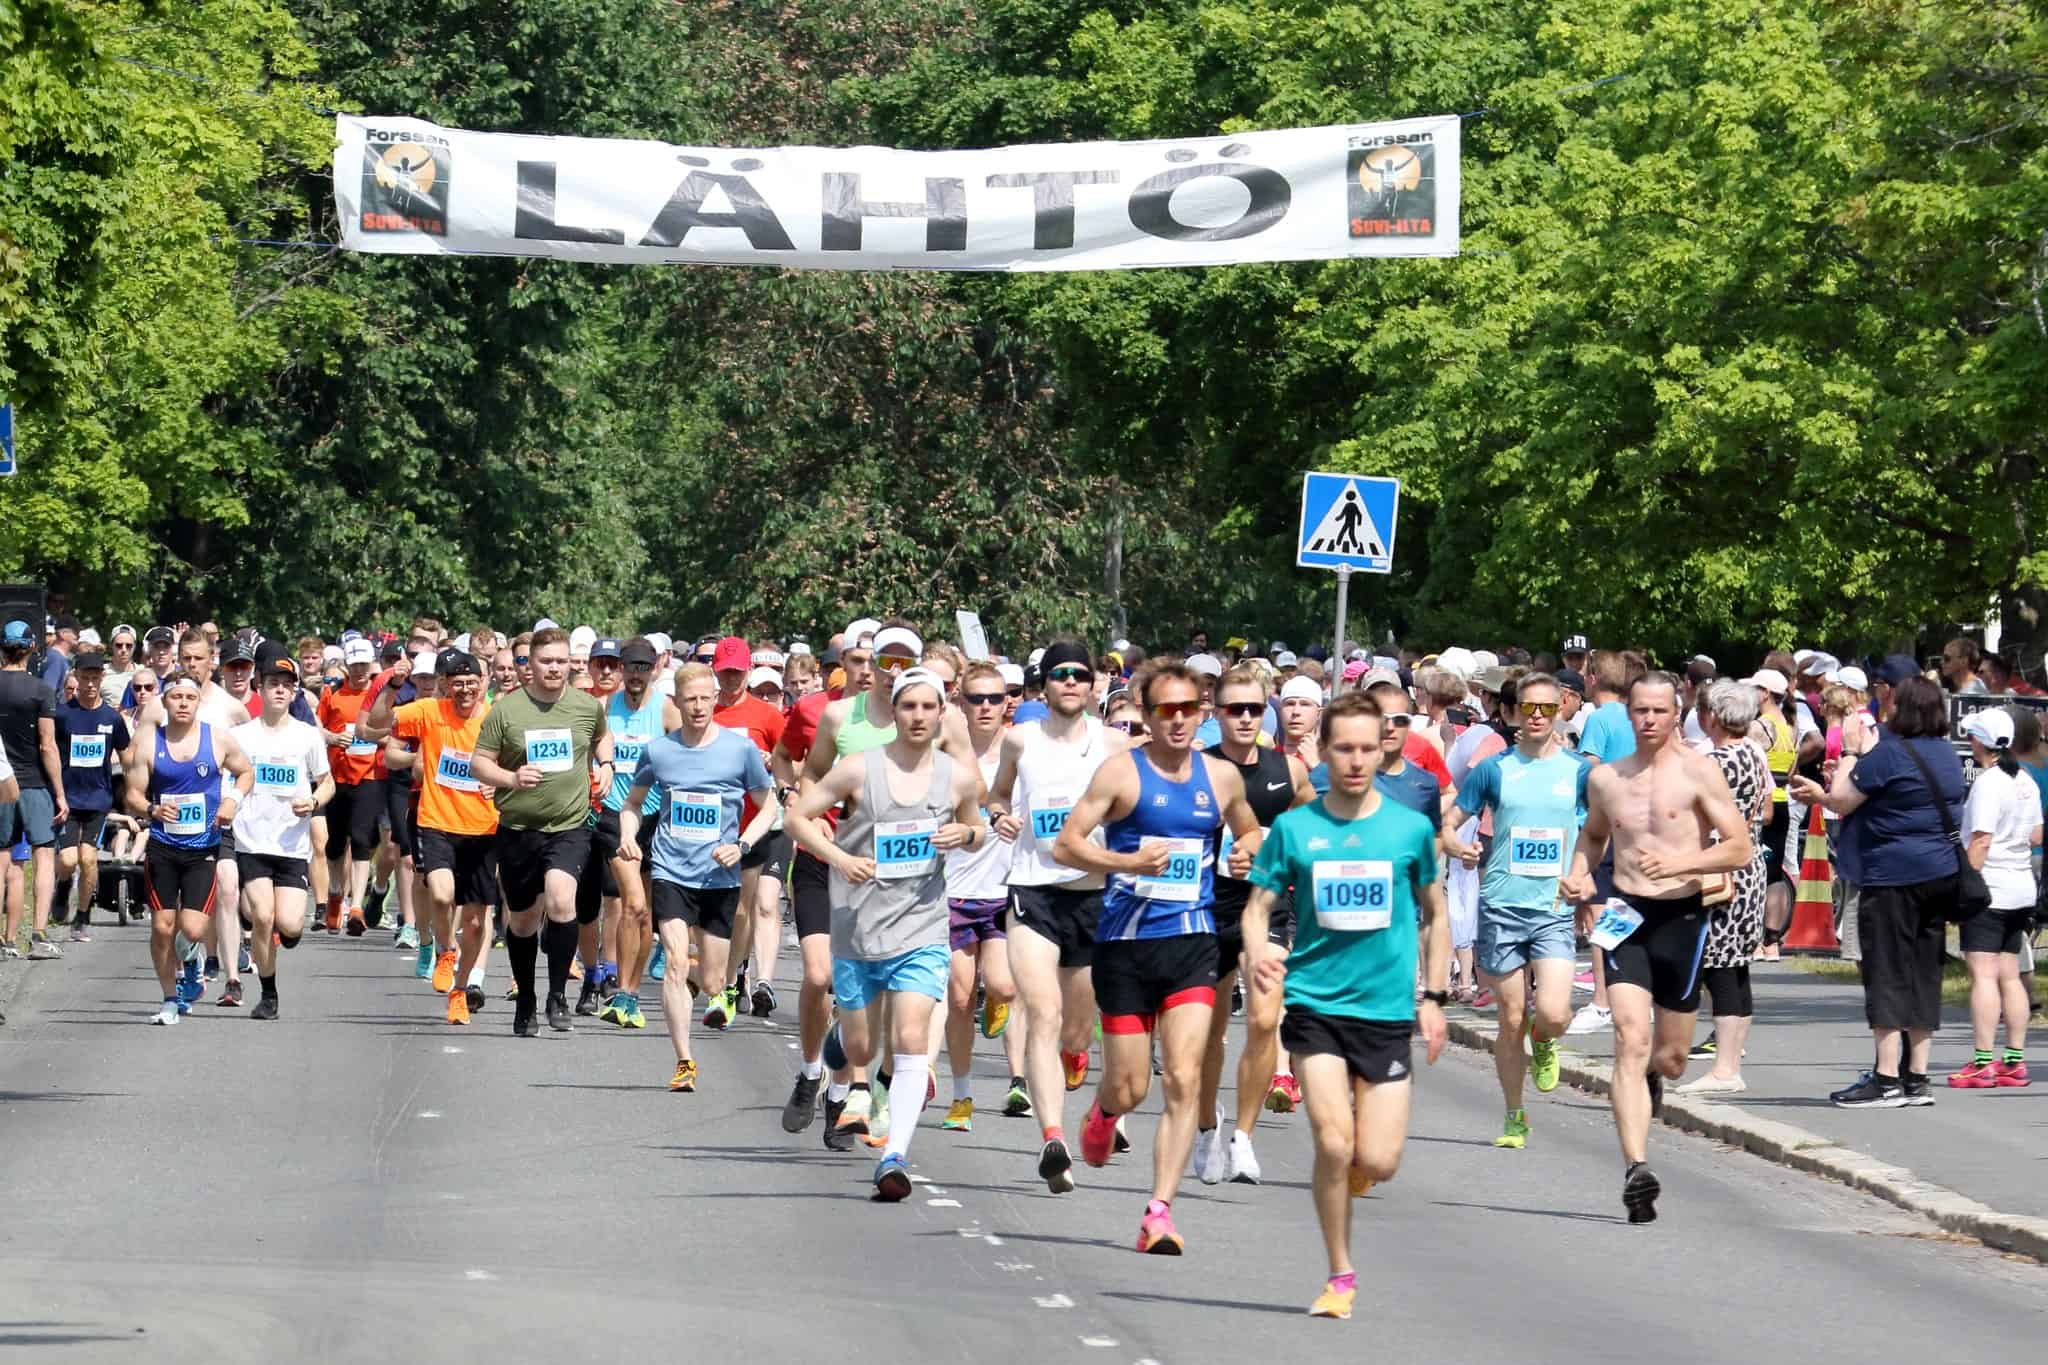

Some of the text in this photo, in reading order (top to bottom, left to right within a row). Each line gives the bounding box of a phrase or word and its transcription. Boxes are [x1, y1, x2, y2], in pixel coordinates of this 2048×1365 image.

[366, 129, 449, 146] Forssan
[1348, 132, 1433, 147] Forssan
[515, 143, 1292, 251] LÄHTÖ
[73, 744, 102, 756] 1094
[531, 742, 568, 758] 1234
[260, 766, 295, 783] 1308
[676, 805, 716, 824] 1008
[882, 836, 930, 859] 1267
[1516, 842, 1558, 860] 1293
[1322, 882, 1384, 906] 1098
